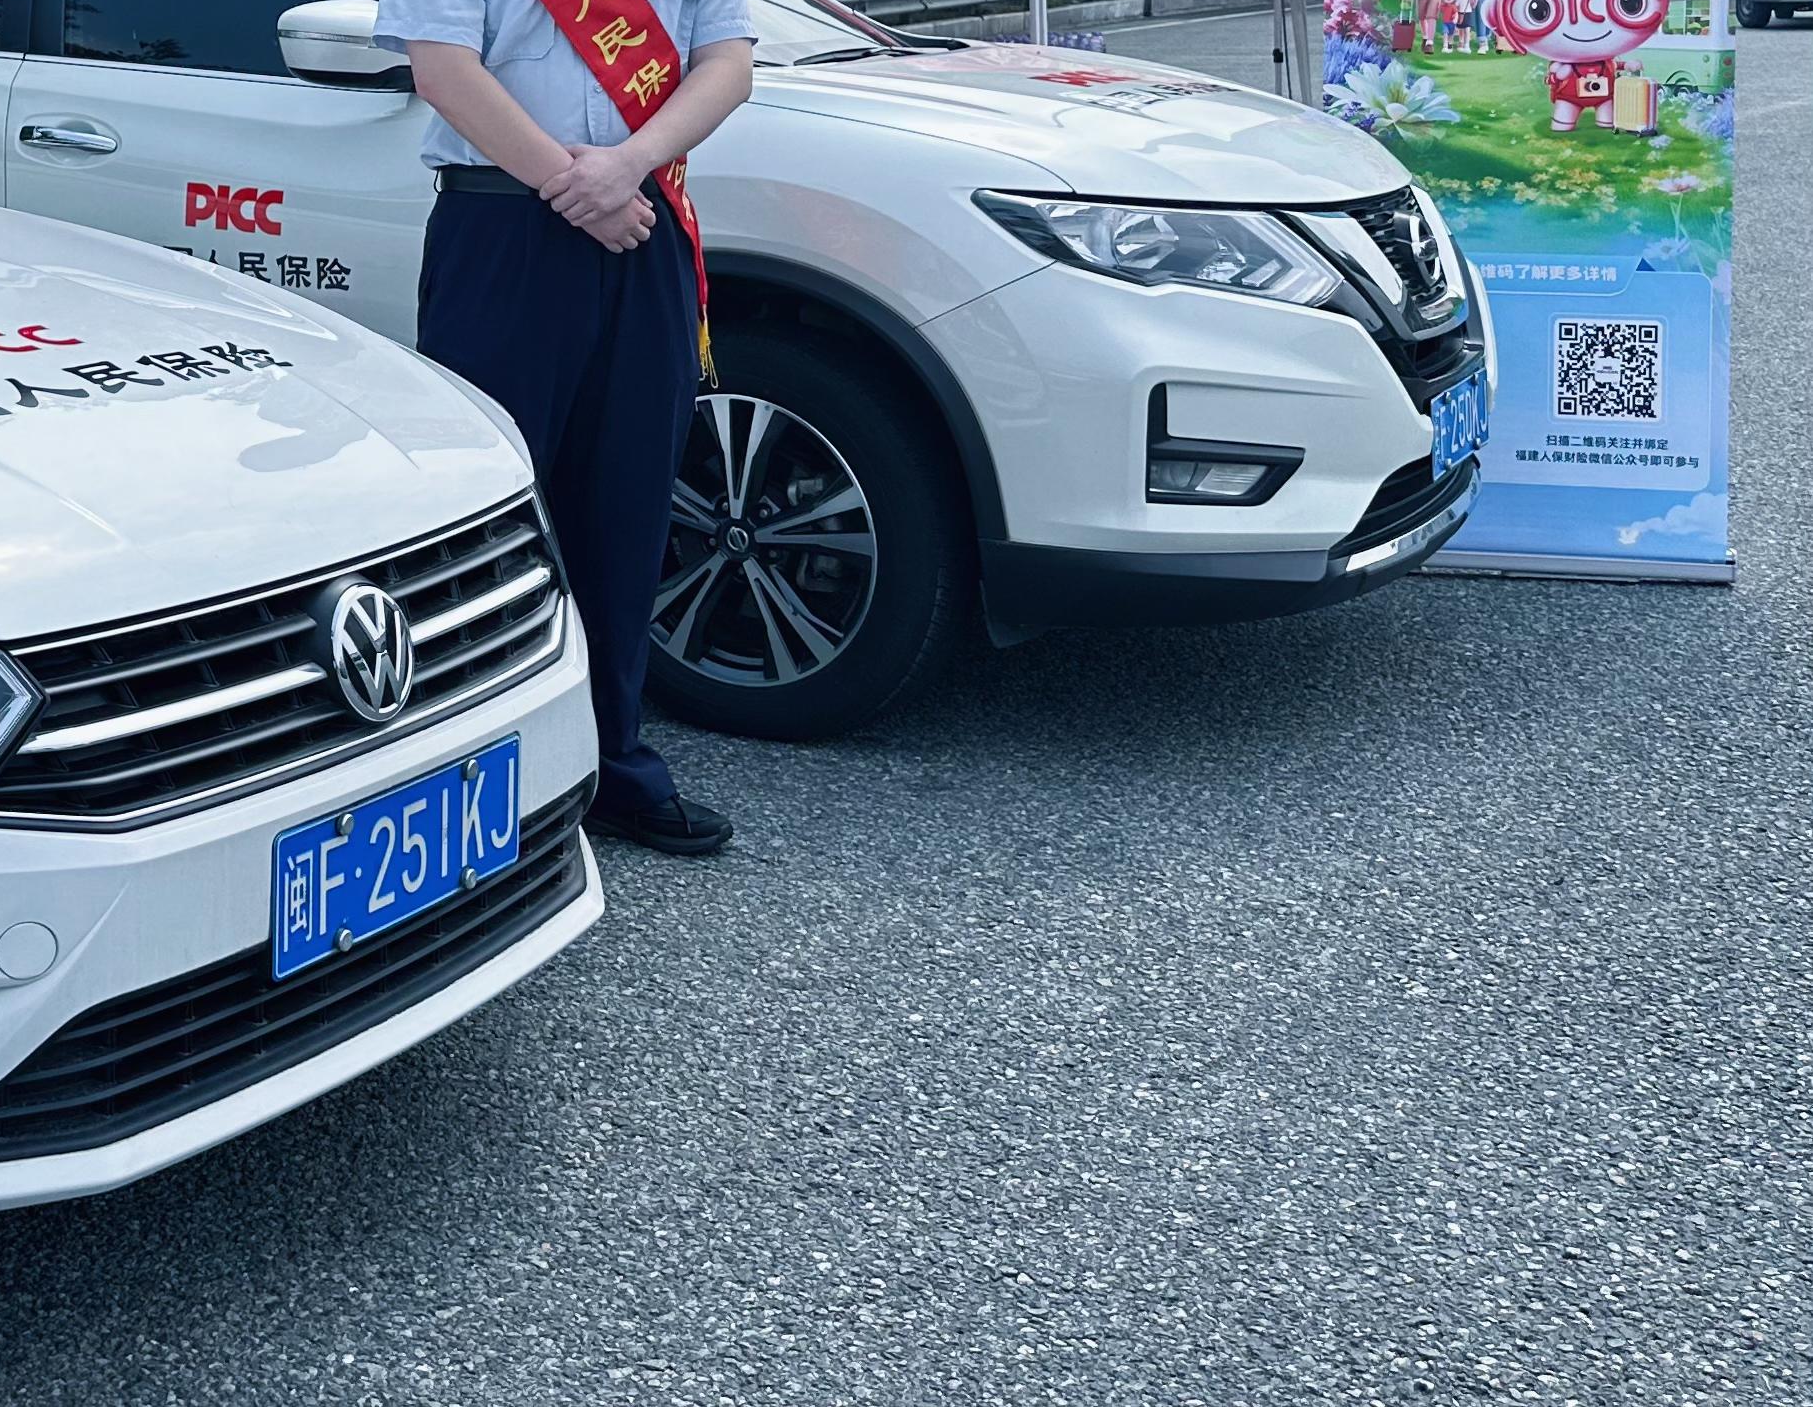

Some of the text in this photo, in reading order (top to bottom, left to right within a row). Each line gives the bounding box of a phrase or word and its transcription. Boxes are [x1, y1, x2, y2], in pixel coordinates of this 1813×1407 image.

[185, 182, 284, 236] PICC
[1515, 449, 1699, 469] 福建人保财险微信公众号即可参与
[1546, 434, 1669, 451] 扫描二维码关注并绑定
[283, 757, 515, 953] 闽F·251KJ
